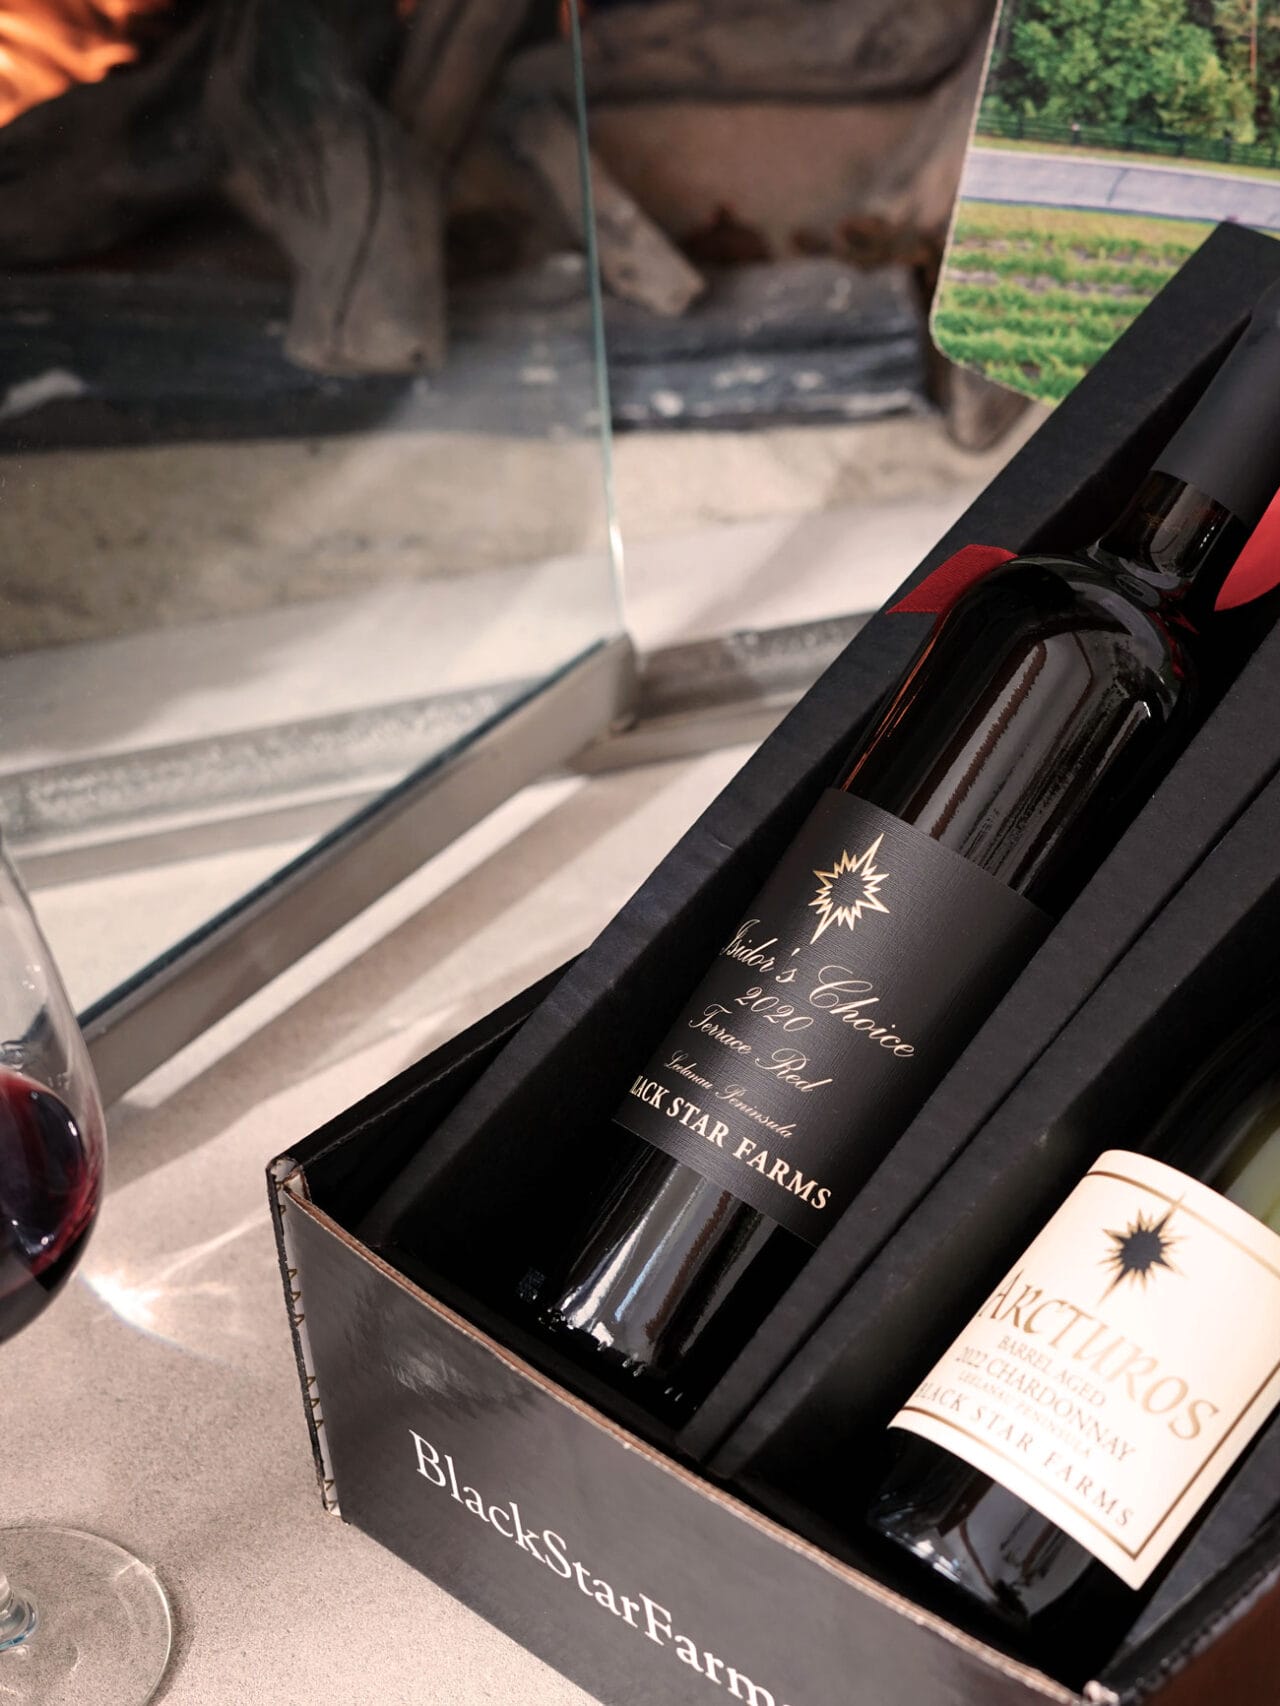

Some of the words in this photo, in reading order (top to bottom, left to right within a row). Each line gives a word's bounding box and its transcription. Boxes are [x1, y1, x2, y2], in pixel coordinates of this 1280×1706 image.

[719, 918, 801, 985] Isidor's
[809, 965, 915, 1058] Choice
[734, 986, 814, 1033] 2020
[689, 1003, 752, 1056] Terrace
[755, 1047, 833, 1093] Red
[629, 1075, 670, 1110] LACK
[666, 1096, 729, 1148] STAR
[732, 1136, 832, 1210] FARMS
[715, 1084, 801, 1139] Peninsula
[977, 1268, 1220, 1442] ARCTUROS
[985, 1357, 1137, 1464] CHARDONNAY
[1054, 1367, 1107, 1407] AGED
[970, 1404, 1035, 1452] STAR
[1042, 1449, 1136, 1528] FARMS
[409, 1429, 793, 1706] BlackStarFarm
